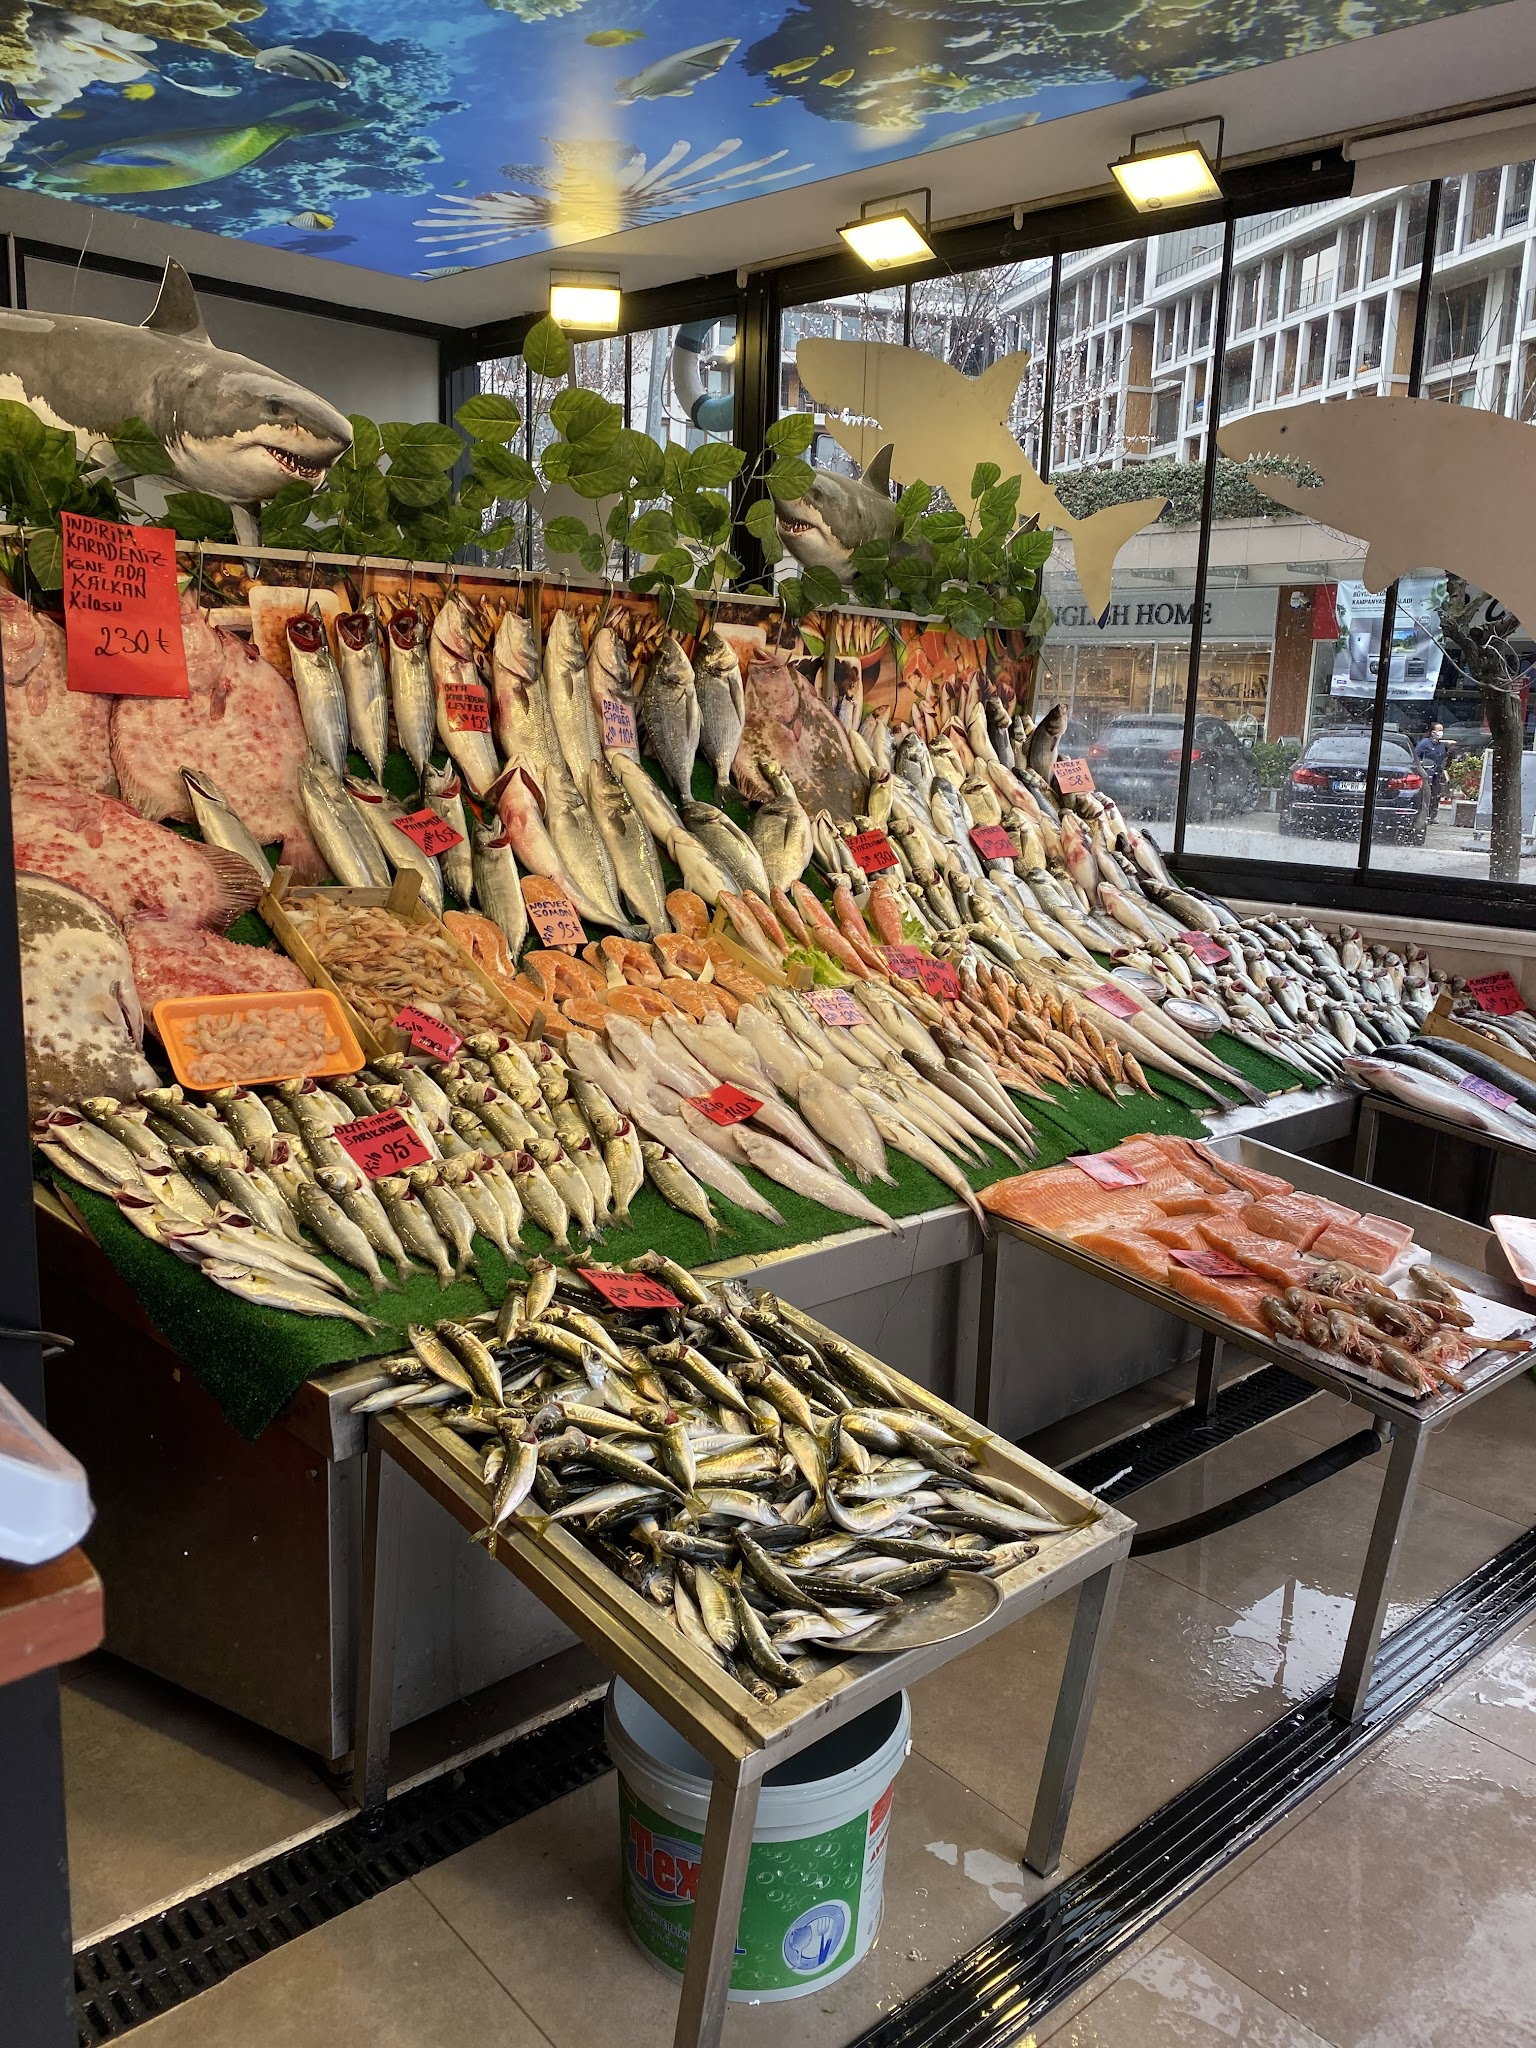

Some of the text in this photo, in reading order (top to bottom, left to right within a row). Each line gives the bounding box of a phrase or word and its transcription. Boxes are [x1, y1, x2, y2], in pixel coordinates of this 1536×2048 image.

[66, 529, 168, 567] KARADENİZ
[71, 572, 147, 599] KALKAN
[114, 563, 147, 585] ADA
[69, 590, 122, 612] Kilosu
[1135, 602, 1213, 626] HOME
[94, 626, 150, 657] 230
